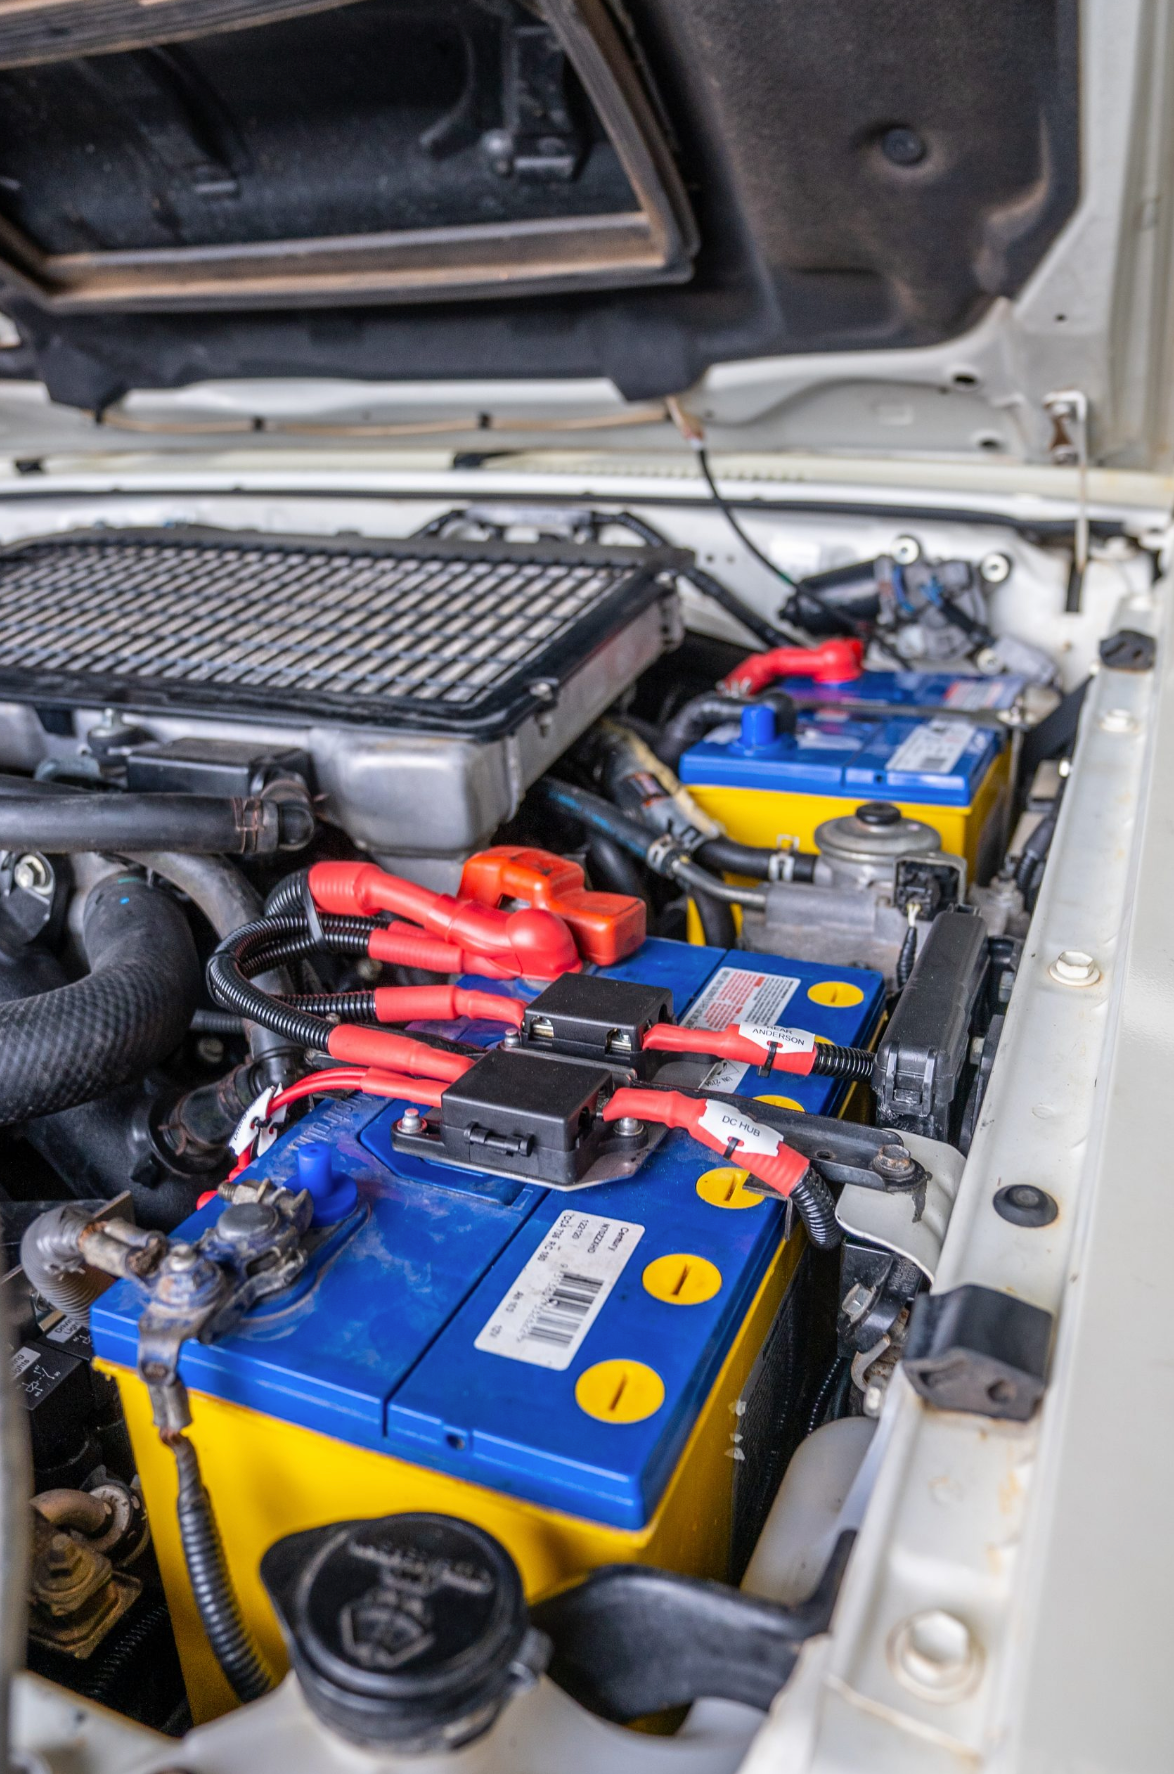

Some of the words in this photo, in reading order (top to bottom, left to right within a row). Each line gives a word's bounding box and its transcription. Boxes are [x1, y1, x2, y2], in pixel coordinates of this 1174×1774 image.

[752, 1028, 805, 1046] ANDERSON
[721, 1115, 738, 1126] DC
[739, 1121, 761, 1137] HUB
[608, 1226, 630, 1252] Century
